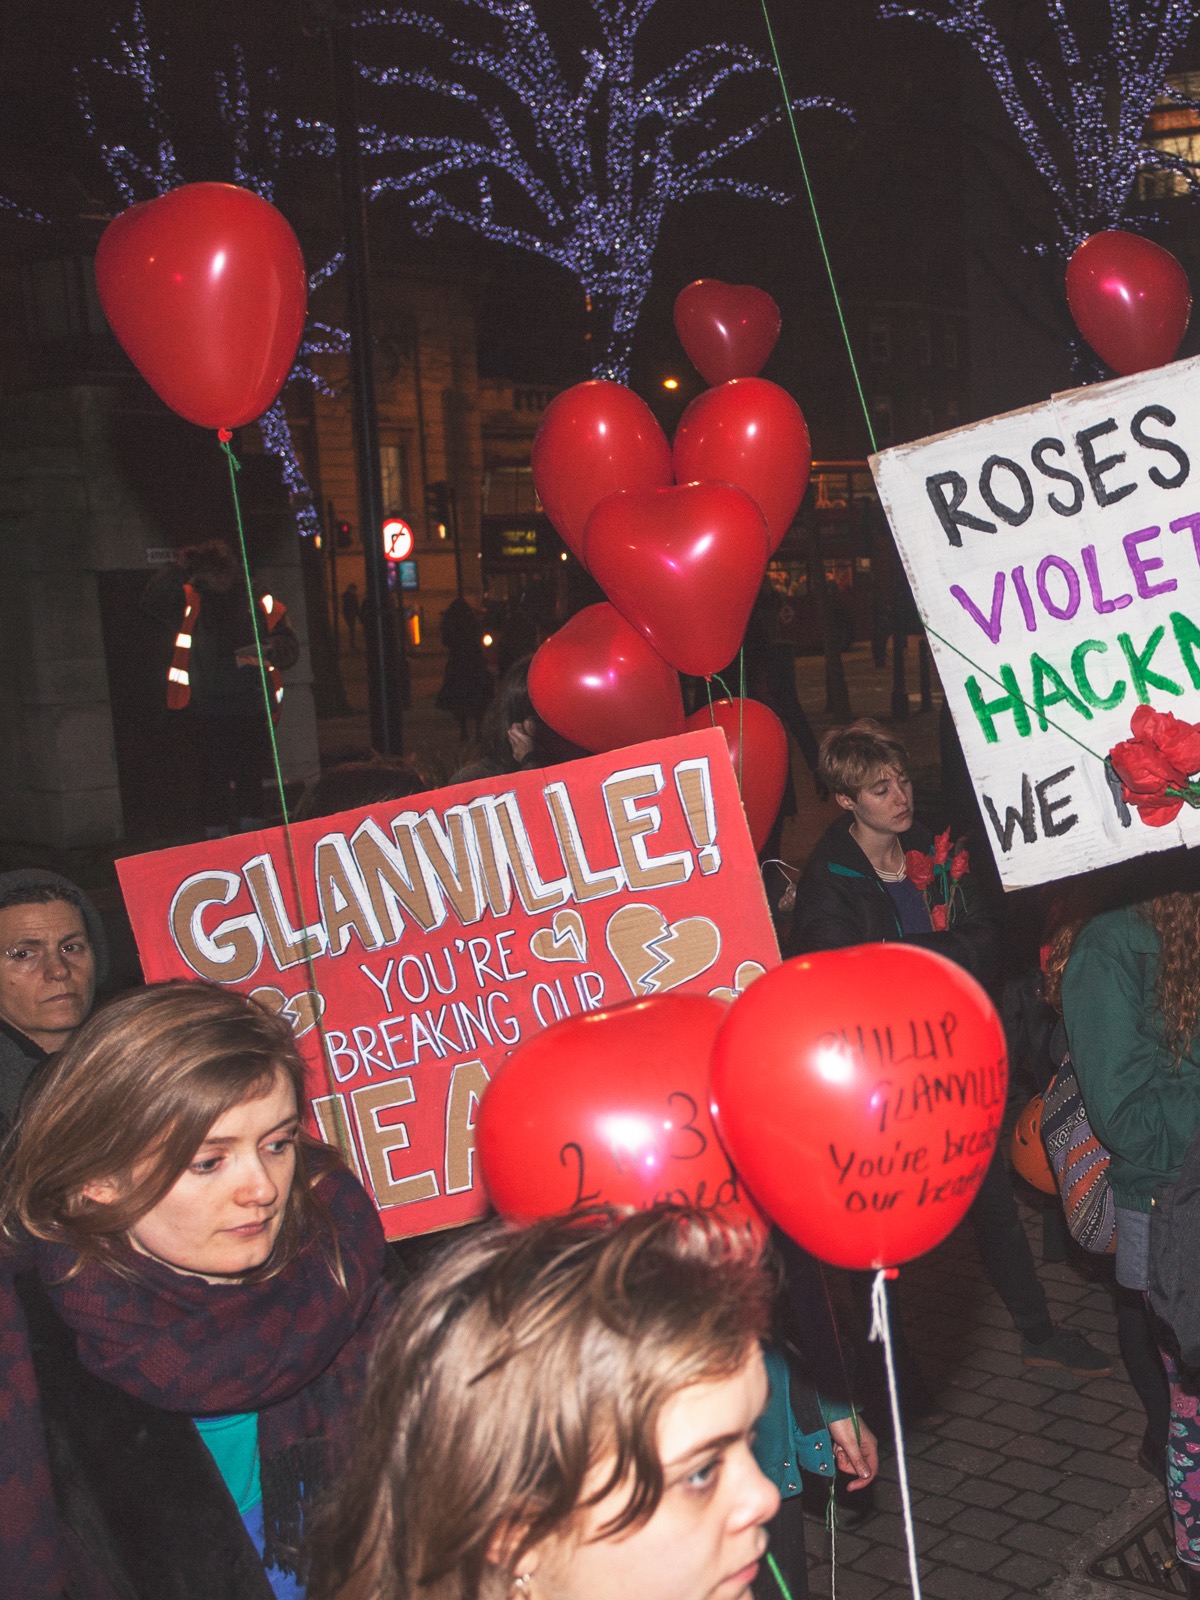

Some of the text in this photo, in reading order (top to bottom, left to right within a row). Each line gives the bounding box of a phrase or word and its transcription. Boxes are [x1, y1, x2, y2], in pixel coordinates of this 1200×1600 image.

[925, 404, 1190, 547] ROSES
[982, 765, 1078, 853] WE
[169, 757, 723, 984] GLANVILLE!
[360, 930, 527, 1012] YOU'RE
[531, 971, 605, 1027] OUR
[324, 991, 521, 1083] BREAKING
[844, 1190, 903, 1214] our
